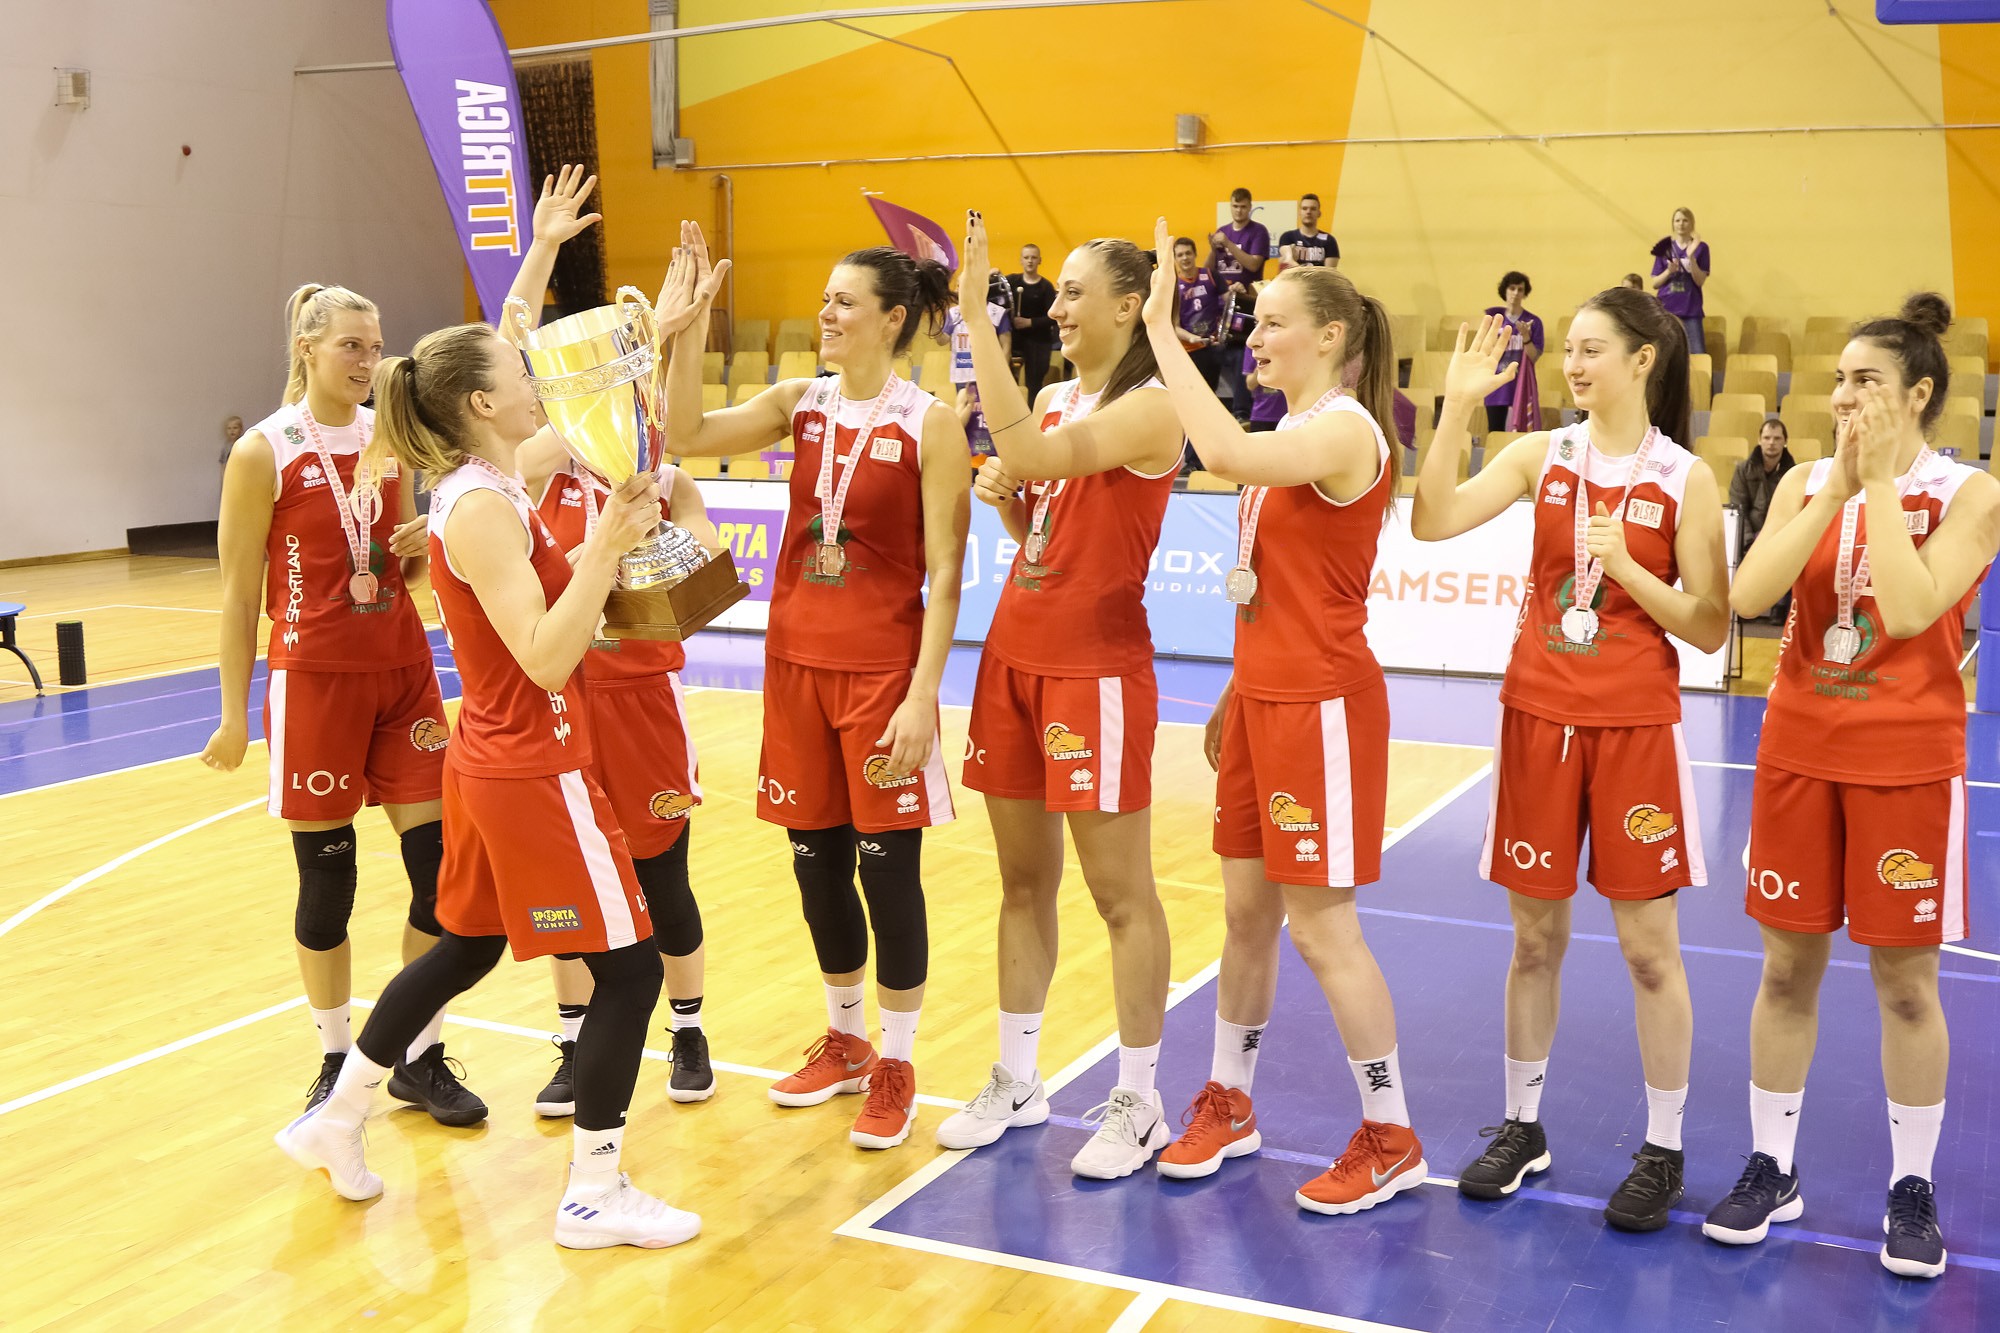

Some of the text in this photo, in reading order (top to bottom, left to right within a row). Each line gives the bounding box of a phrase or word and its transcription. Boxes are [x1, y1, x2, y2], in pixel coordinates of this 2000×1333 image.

[285, 534, 303, 623] SPORTLAND
[1053, 749, 1093, 760] LAUVAS
[878, 776, 919, 789] LAUVAS
[1280, 822, 1320, 832] LAUVAS
[1894, 878, 1939, 890] LAUVAS
[532, 909, 577, 922] SPORTA
[536, 920, 579, 929] PUNKTS
[1361, 1061, 1393, 1092] PEAK
